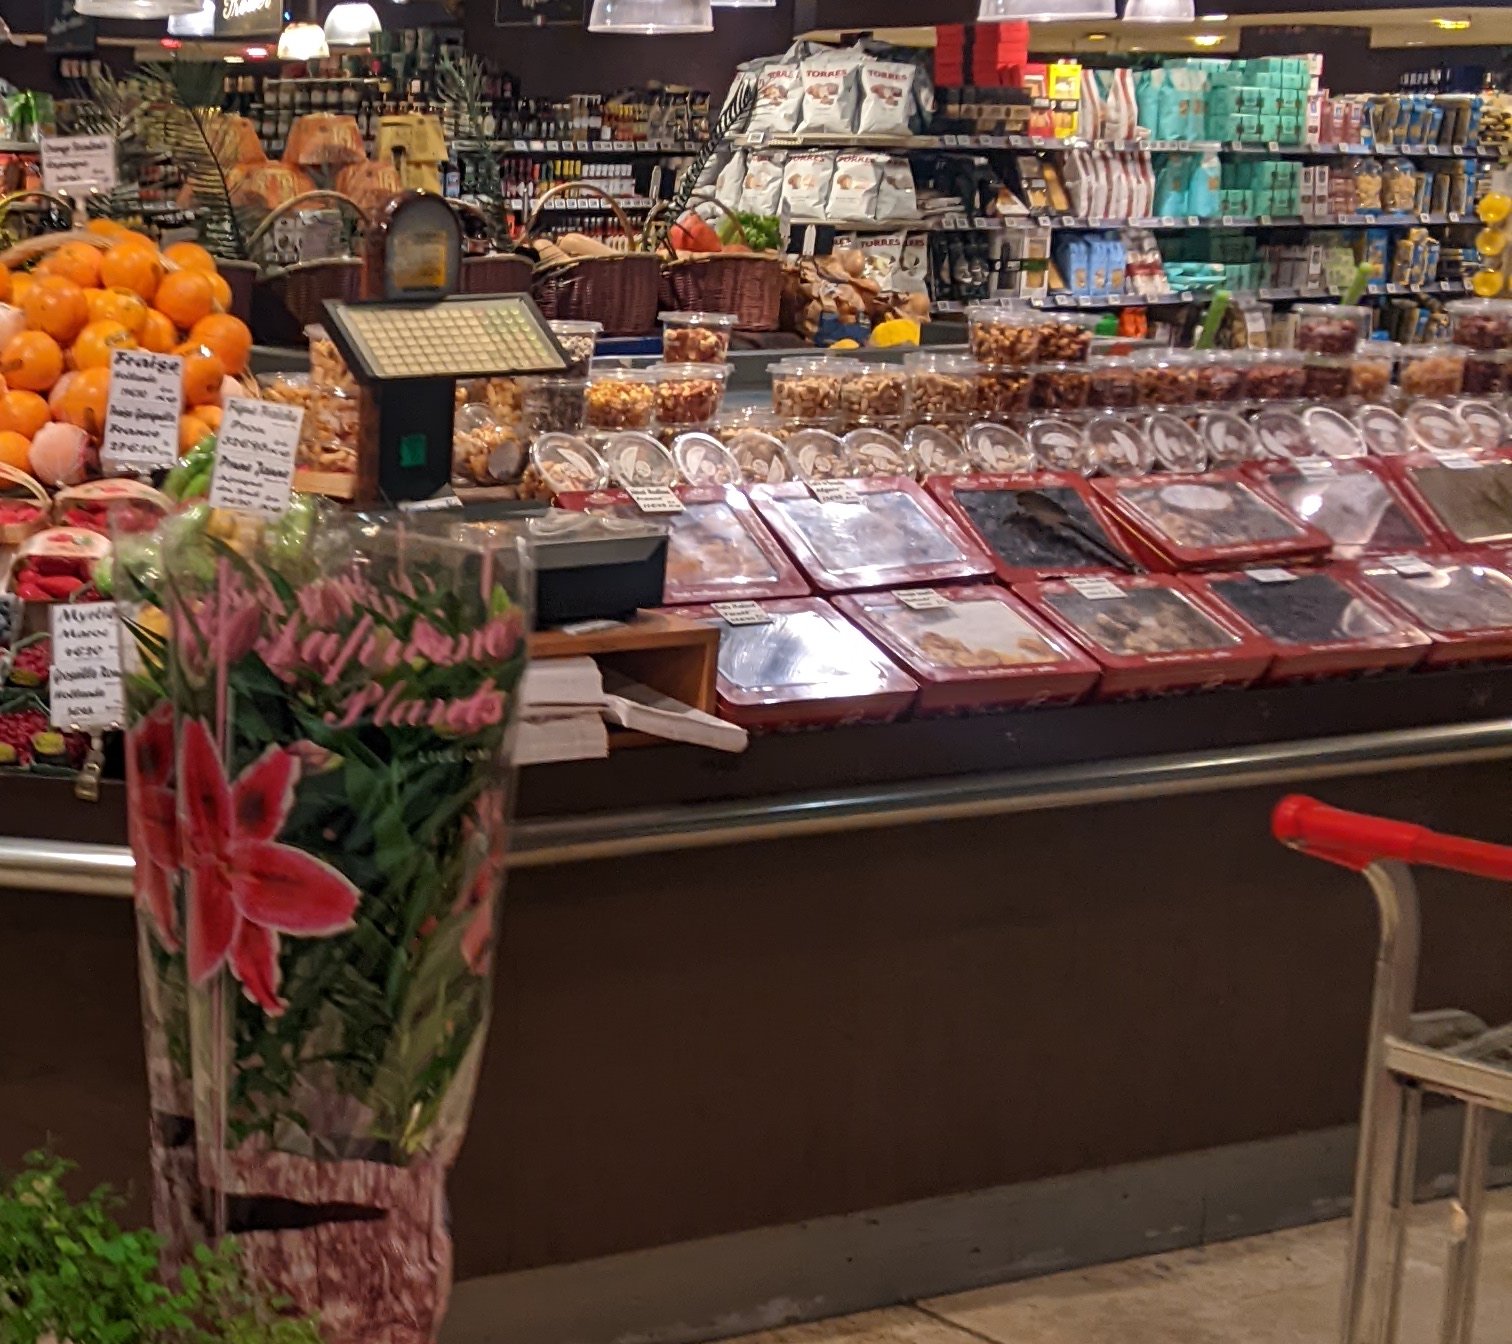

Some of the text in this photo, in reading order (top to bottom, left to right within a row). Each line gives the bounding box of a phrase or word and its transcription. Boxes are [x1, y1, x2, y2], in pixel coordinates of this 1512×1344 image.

[806, 69, 847, 78] TORRES
[861, 238, 901, 248] TORRES
[114, 351, 180, 376] Fraise
